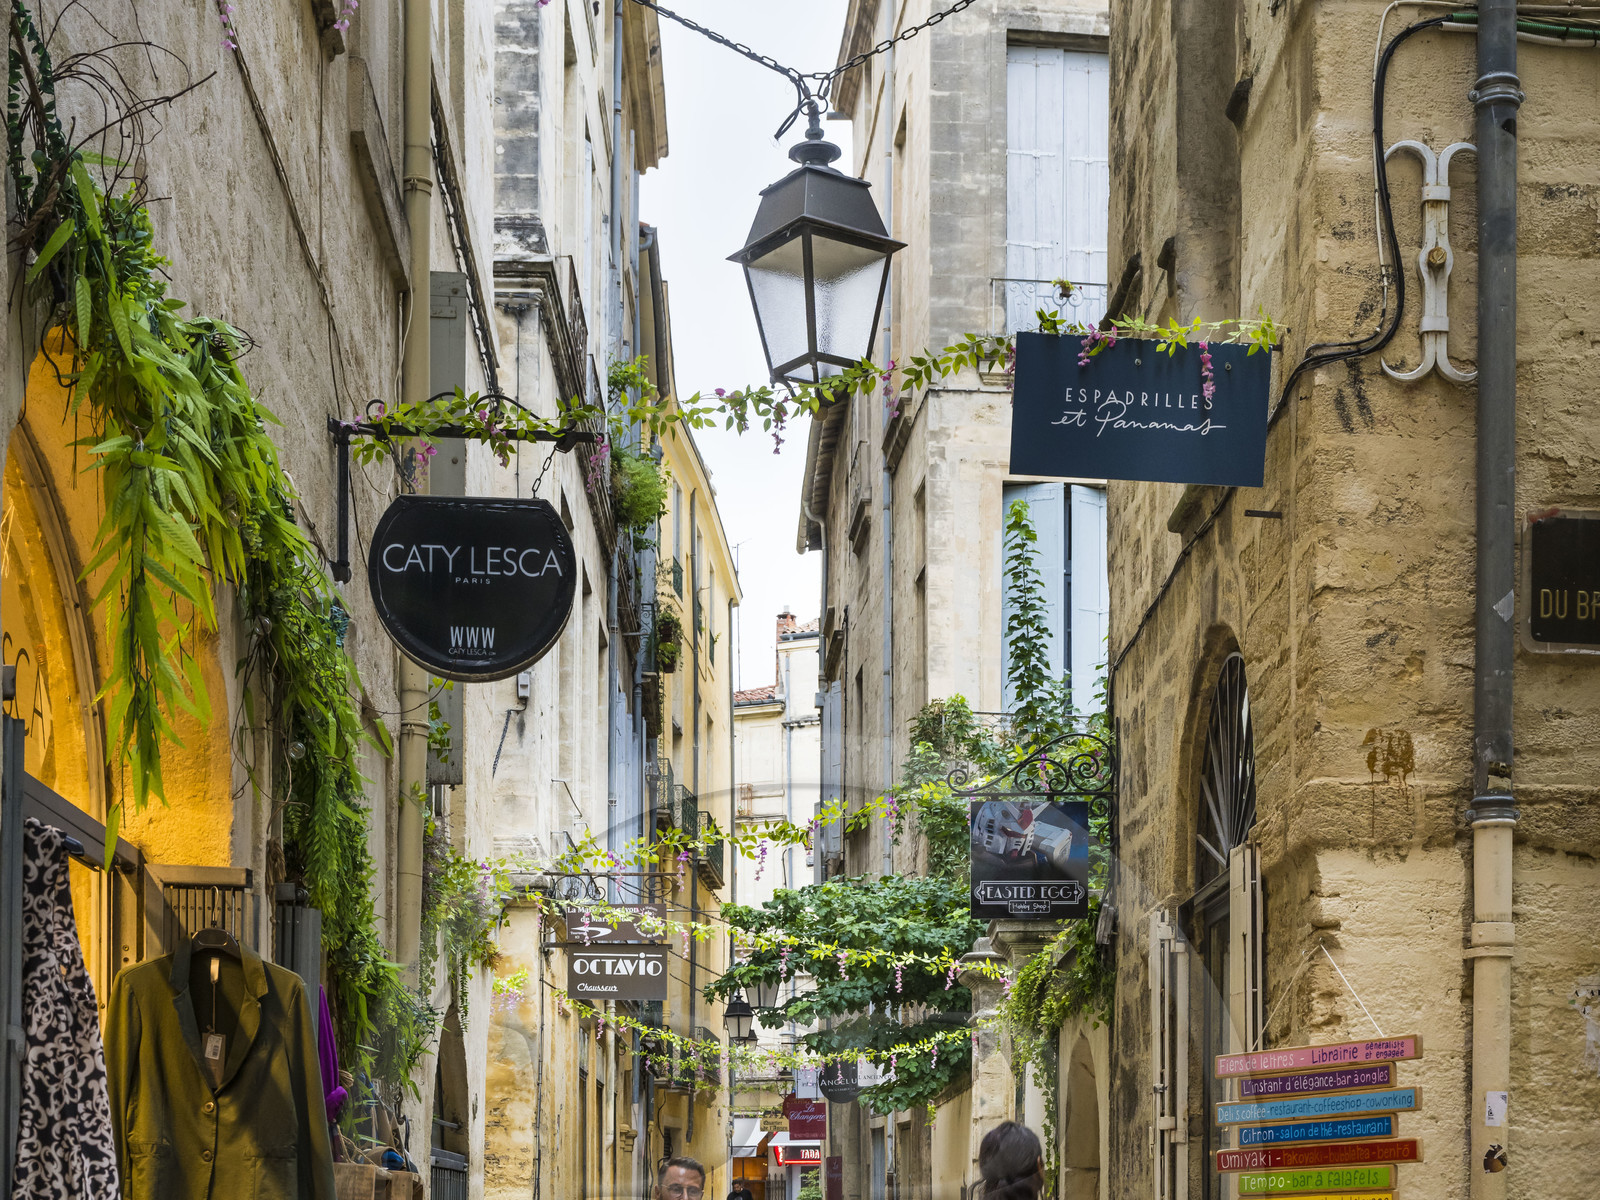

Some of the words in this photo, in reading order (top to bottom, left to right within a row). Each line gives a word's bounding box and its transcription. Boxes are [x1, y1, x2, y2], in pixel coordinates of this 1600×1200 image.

[1066, 388, 1213, 410] ESPADRILLES
[1051, 409, 1086, 427] et
[1095, 400, 1226, 438] Panamas
[382, 544, 462, 573] CATY
[470, 546, 563, 577] LESCA
[455, 577, 491, 585] PARIS
[1540, 588, 1568, 618] DU
[450, 626, 495, 649] WWW
[986, 886, 1036, 899] EASTER
[1040, 886, 1072, 899] EGG
[1012, 902, 1030, 910] Hobby
[1032, 902, 1047, 910] Shop
[573, 957, 662, 976] OCTAVIO
[577, 982, 618, 992] Chausseur
[1220, 1058, 1244, 1074] Fiers
[1245, 1056, 1257, 1071] de
[1260, 1053, 1294, 1069] lettres
[1312, 1046, 1358, 1064] Librairie
[1365, 1052, 1372, 1060] et
[1243, 1078, 1282, 1094] L'instant
[1360, 1068, 1388, 1084] ongles
[1242, 1128, 1274, 1144] Citron
[1308, 1124, 1318, 1136] de
[1220, 1151, 1272, 1168] Umiyaki
[1241, 1176, 1284, 1190] Tempo
[1328, 1170, 1378, 1187] falafels
